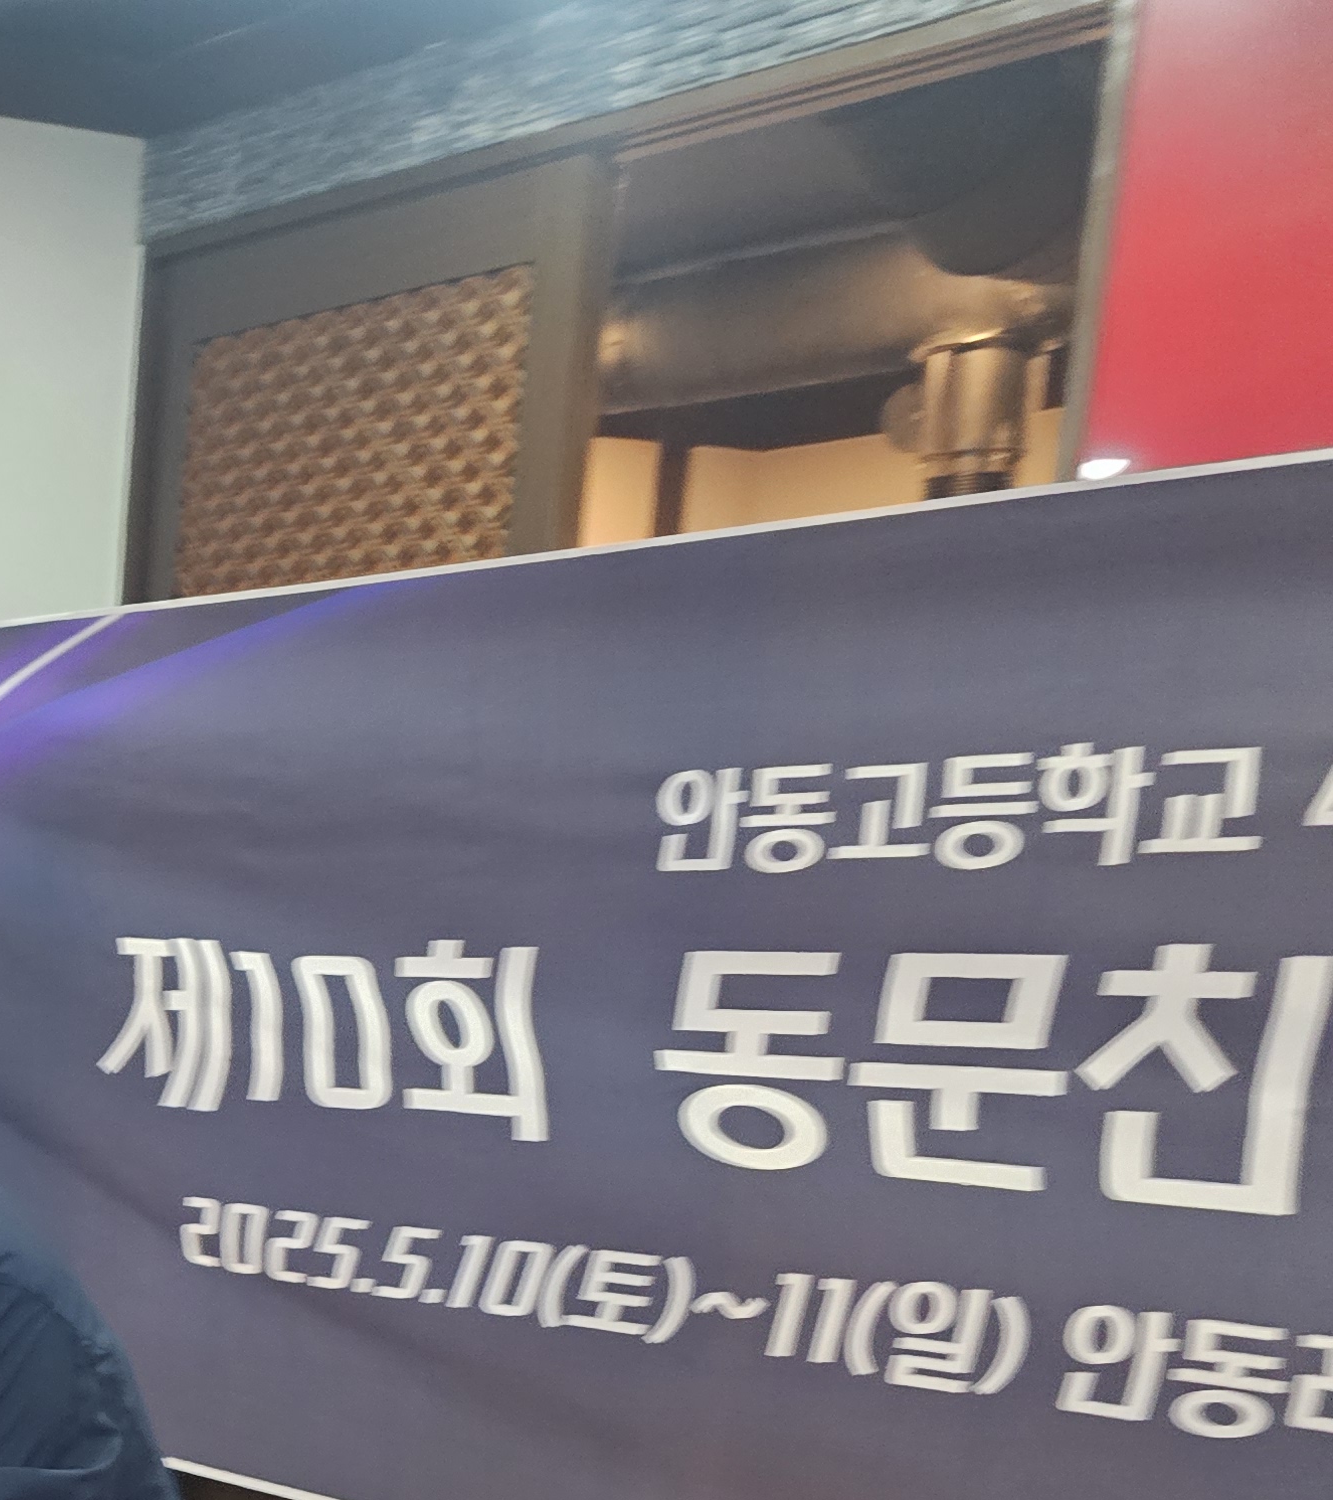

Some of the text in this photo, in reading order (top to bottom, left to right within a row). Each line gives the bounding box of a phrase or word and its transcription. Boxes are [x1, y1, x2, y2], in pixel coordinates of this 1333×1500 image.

[656, 743, 1262, 874] 안동고등학교
[96, 937, 1333, 1215] 제10회 동문친
[179, 1196, 1029, 1395] 2025.5.10(토)~11(일)
